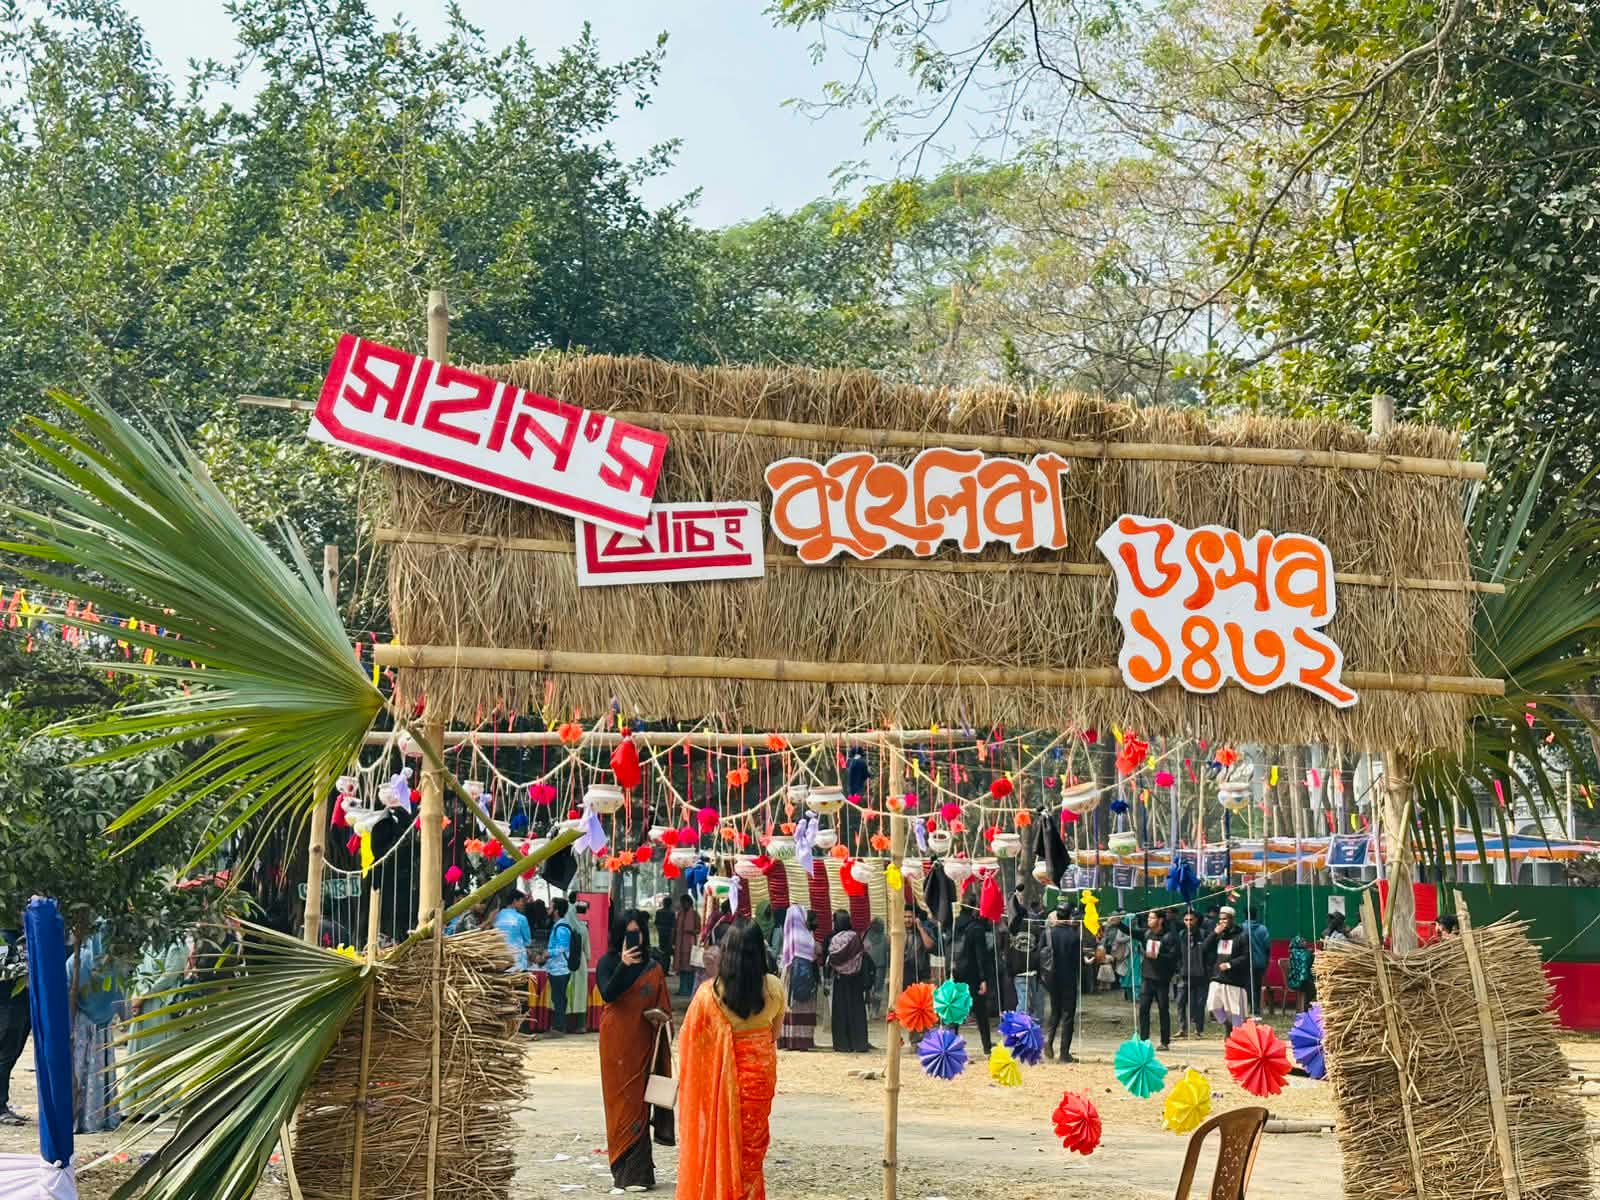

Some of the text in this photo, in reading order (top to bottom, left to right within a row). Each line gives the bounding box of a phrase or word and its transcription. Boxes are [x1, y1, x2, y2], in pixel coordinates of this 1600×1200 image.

[766, 450, 1069, 561] কুহেলিকা
[1118, 516, 1327, 617] উৎসব
[1128, 609, 1357, 701] ১৪৩২
